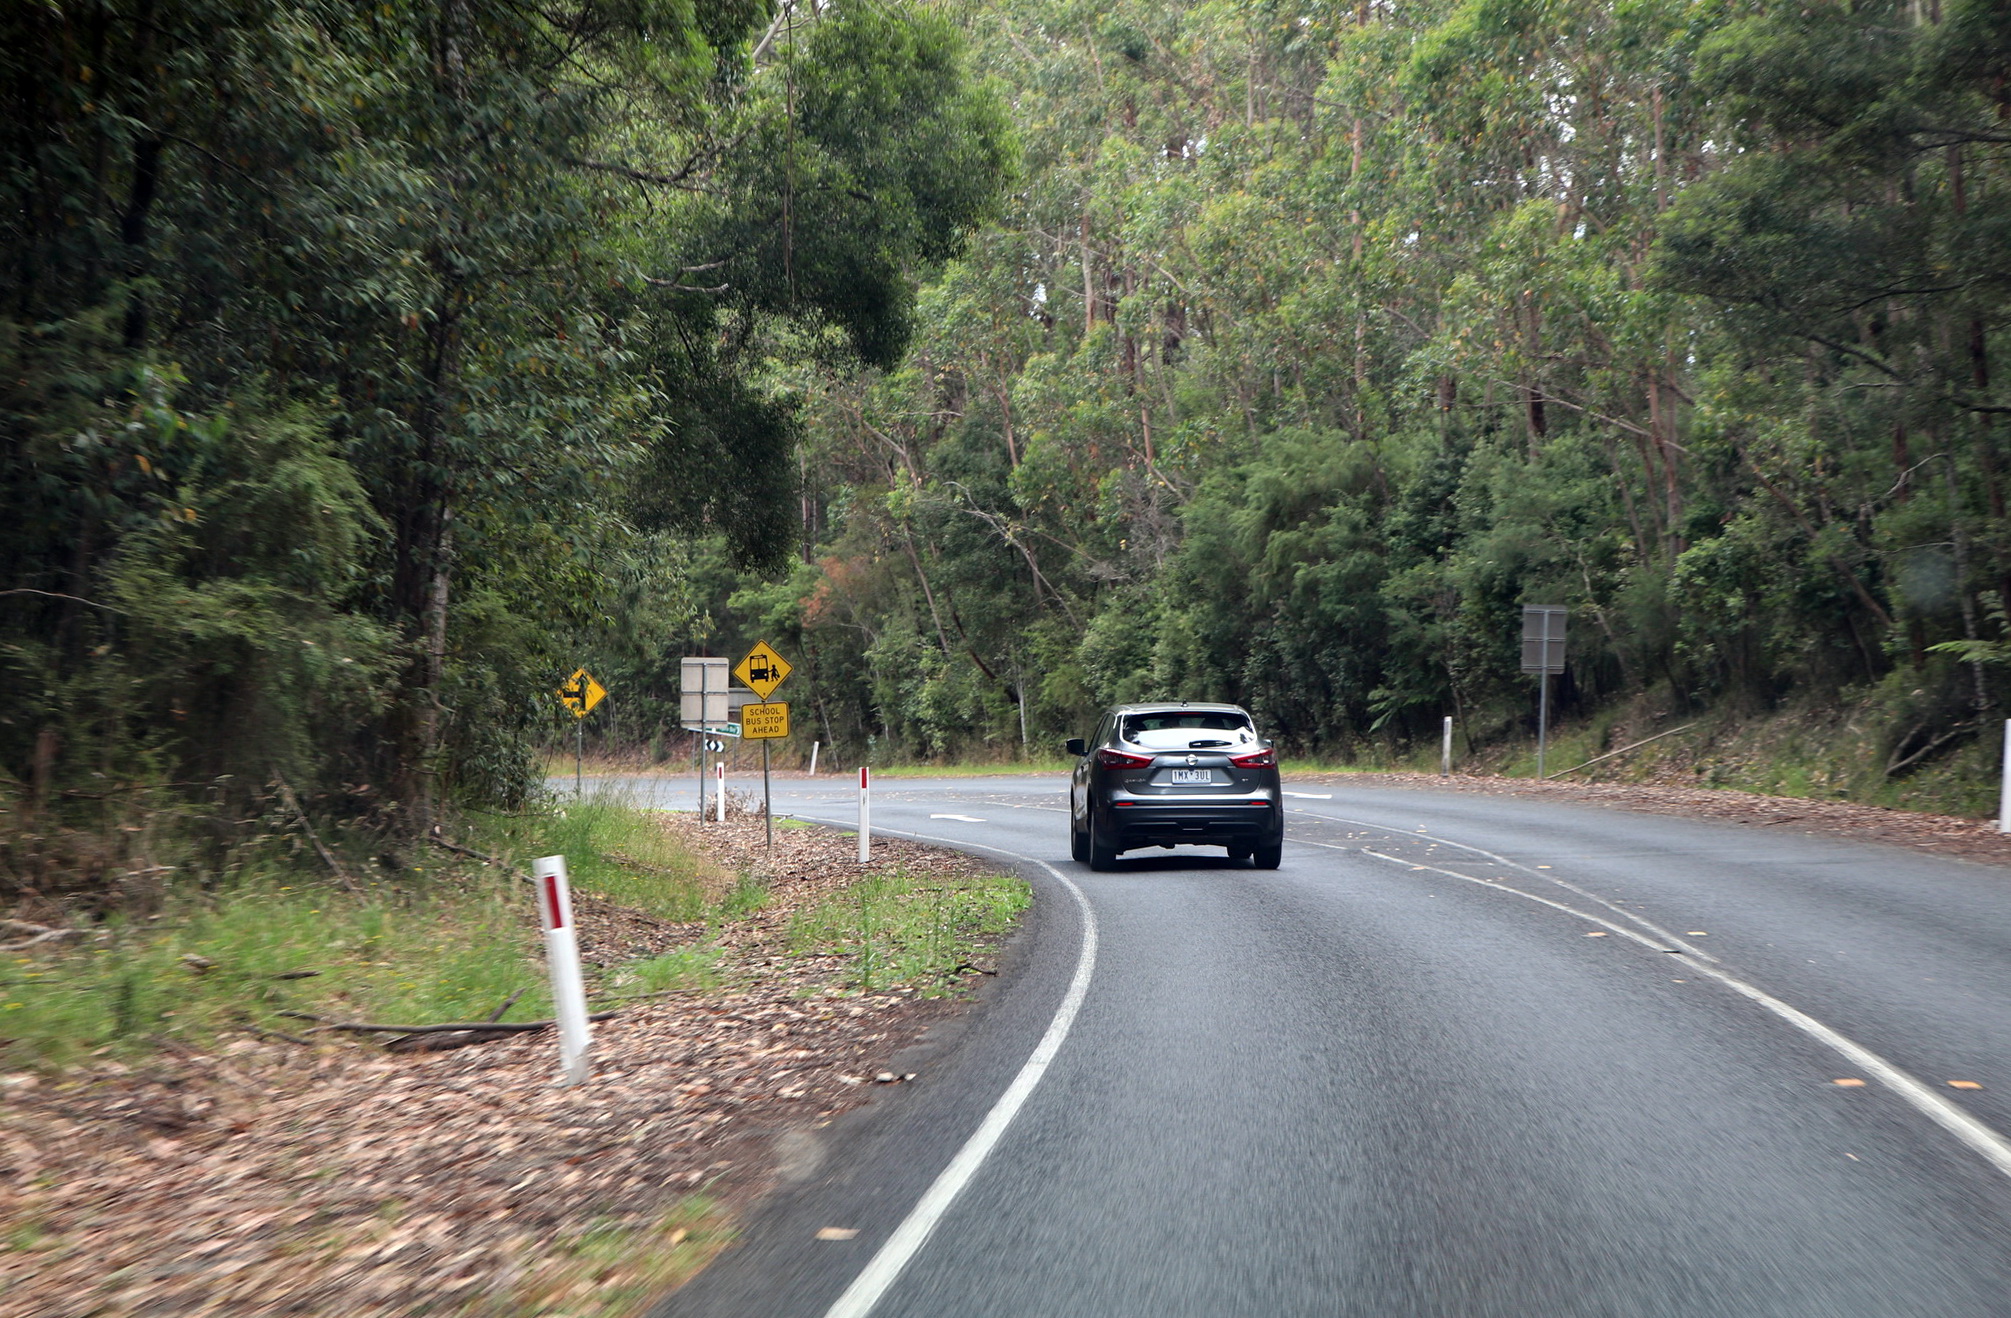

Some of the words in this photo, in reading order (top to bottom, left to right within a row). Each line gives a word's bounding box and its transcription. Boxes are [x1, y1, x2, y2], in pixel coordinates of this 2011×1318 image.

[750, 708, 780, 716] SCHOOL
[745, 717, 761, 725] BUS
[765, 716, 784, 724] STOP
[752, 726, 779, 734] AHEAD
